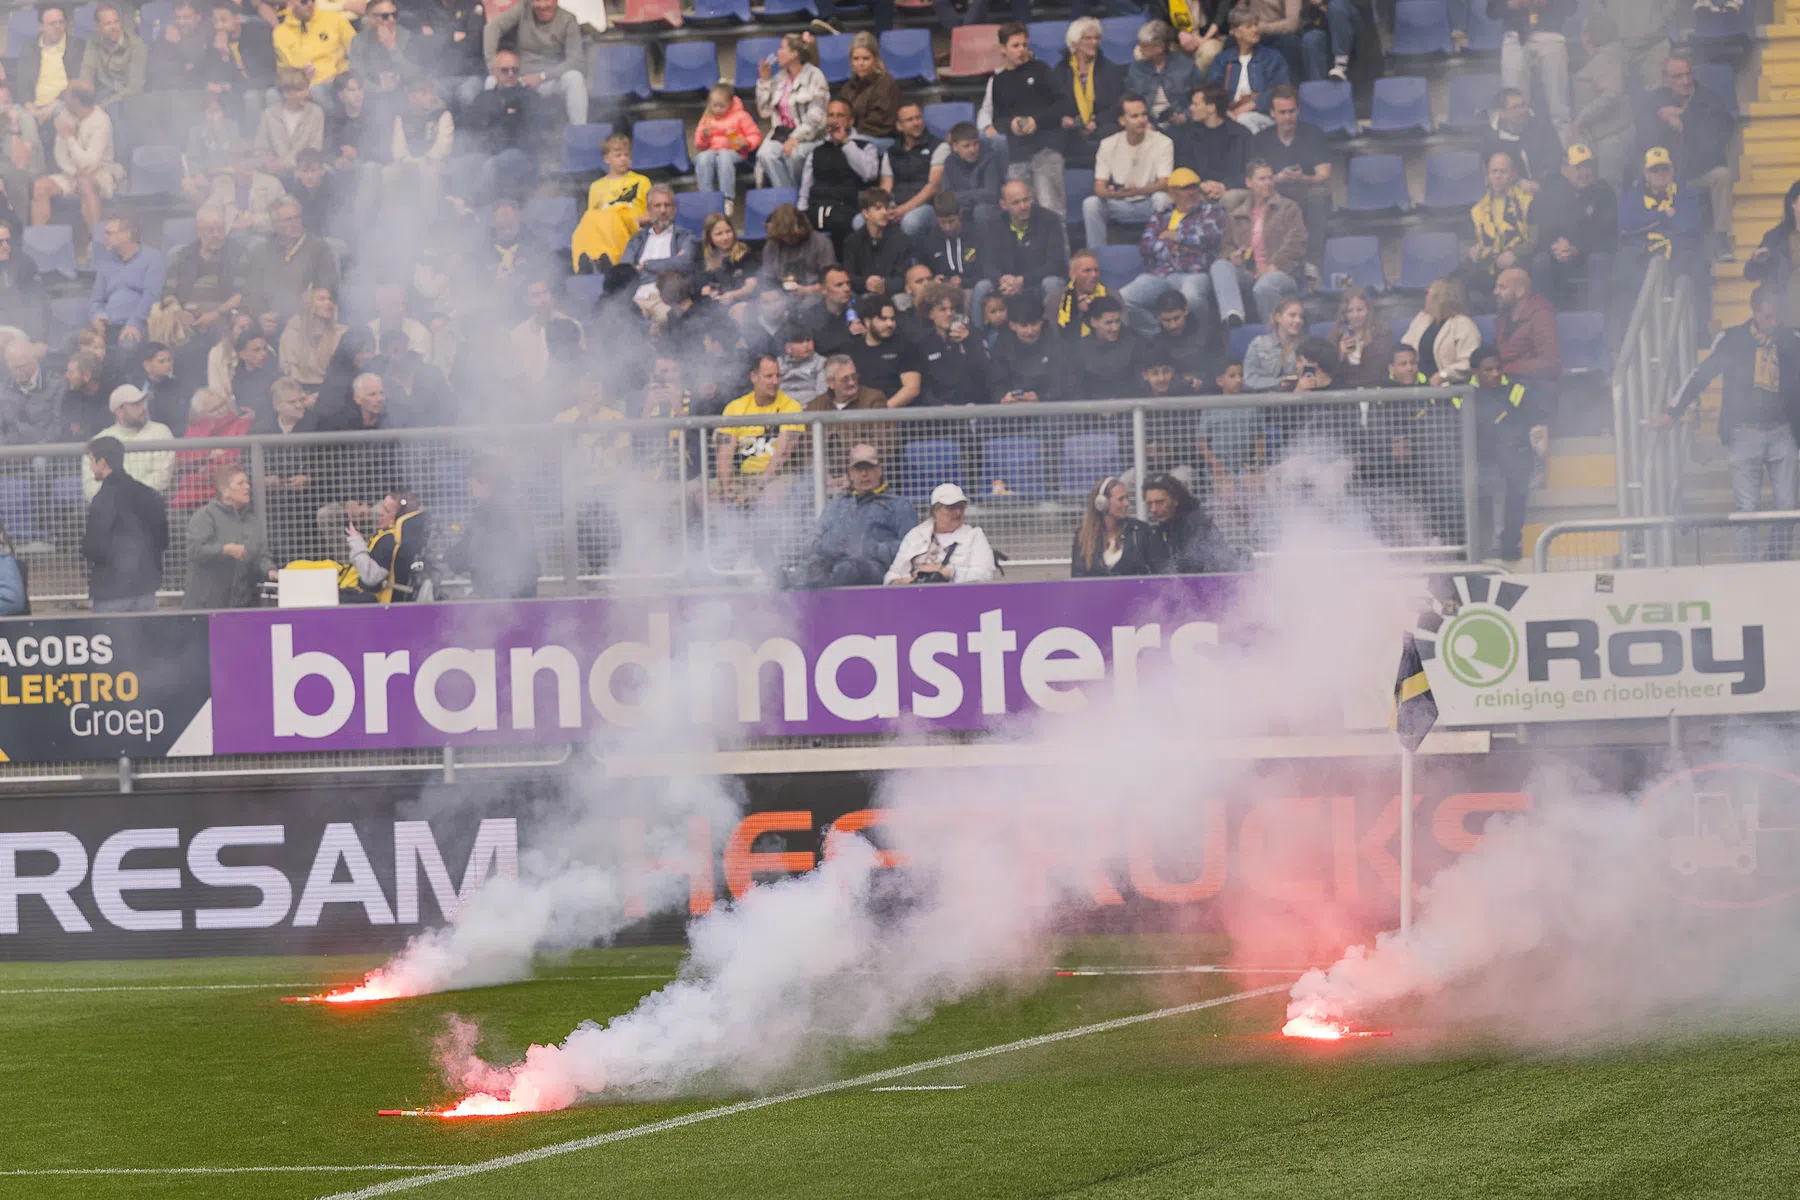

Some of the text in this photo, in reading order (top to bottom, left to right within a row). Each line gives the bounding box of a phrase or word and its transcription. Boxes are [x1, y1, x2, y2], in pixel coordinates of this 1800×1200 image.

[1606, 600, 1711, 625] van
[0, 634, 114, 667] ACOBS
[1525, 618, 1766, 696] Roy
[271, 608, 1219, 738] brandmasters
[1475, 680, 1724, 710] reiniging en rioolbeheer
[70, 703, 164, 742] Groep
[0, 817, 519, 934] RESAM
